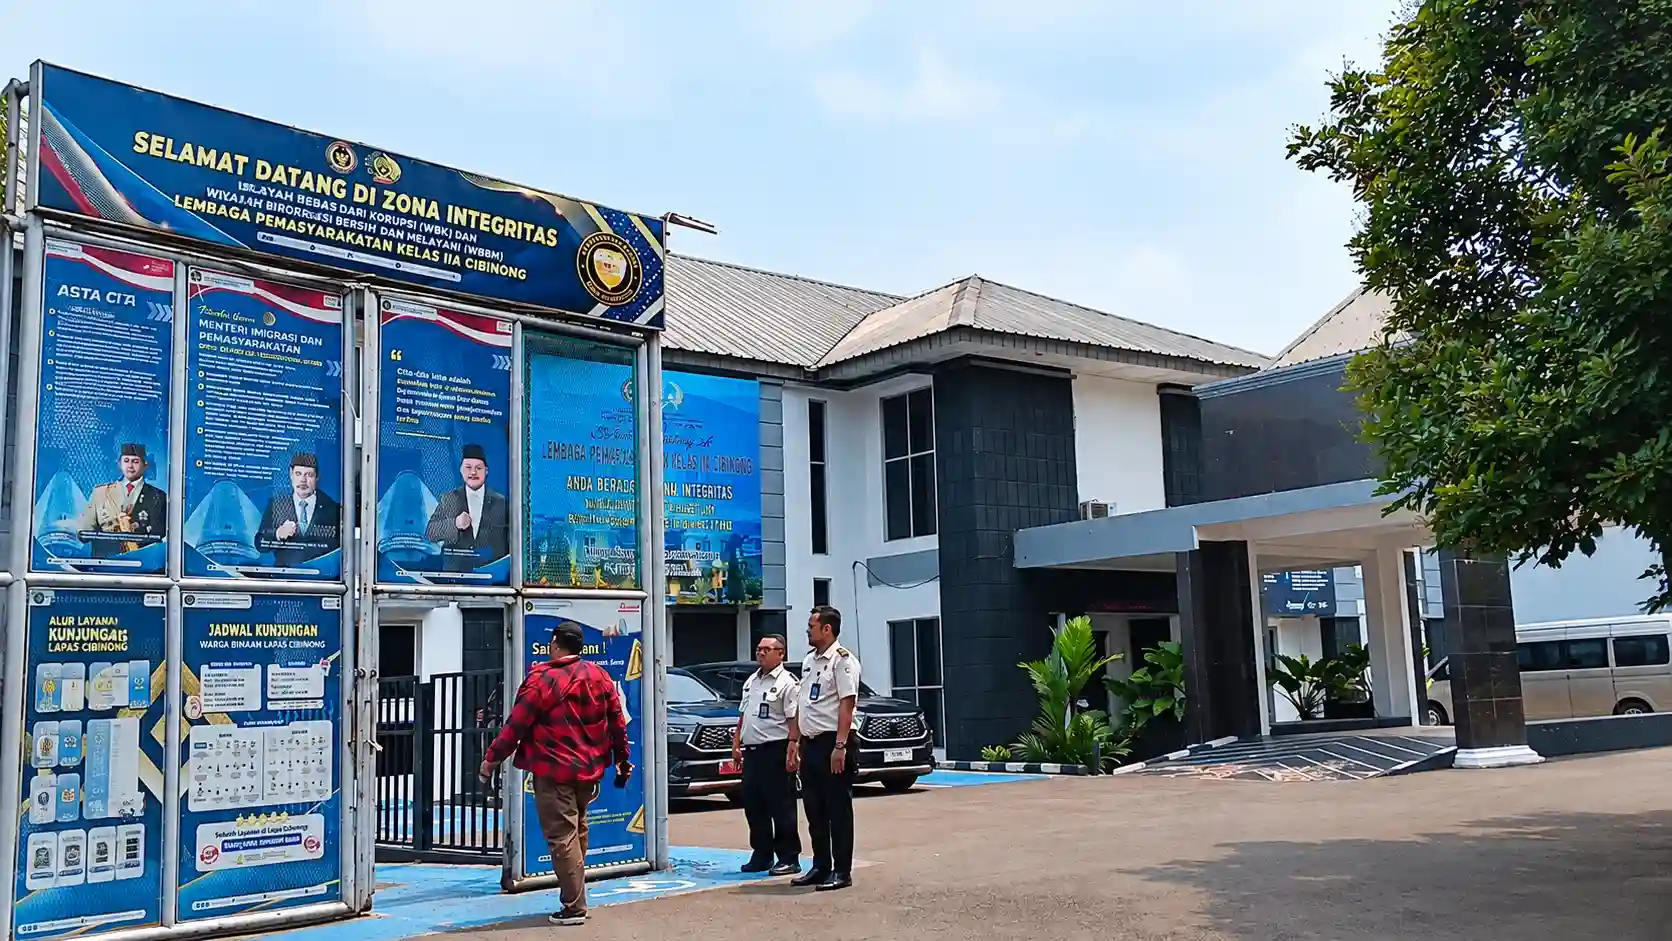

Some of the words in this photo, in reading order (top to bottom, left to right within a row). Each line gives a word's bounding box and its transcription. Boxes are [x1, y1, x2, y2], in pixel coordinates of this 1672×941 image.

[133, 131, 249, 175] SELAMAT
[255, 159, 347, 199] DATANG
[353, 183, 376, 206] DI
[382, 189, 440, 220] ZONA
[447, 204, 558, 247] INTEGRITAS
[297, 194, 337, 211] BEBAS
[339, 204, 366, 218] DARI
[370, 211, 417, 230] KORUPSI
[420, 222, 452, 239] (WBK)
[455, 231, 477, 242] DAN
[174, 194, 250, 222] LEMBAGA
[255, 212, 393, 252] PEMASYARAKATAN
[396, 242, 440, 262] KELAS
[444, 253, 461, 267] IIA
[465, 258, 527, 280] CIBINONG
[336, 215, 376, 233] BERSIH
[380, 226, 404, 240] DAN
[407, 232, 461, 252] MELAYANI
[464, 244, 504, 262] (WBBM)
[57, 284, 100, 302] ASTA
[199, 319, 248, 335] MENTERI
[251, 327, 297, 343] IMIGRASI
[300, 336, 323, 346] DAN
[199, 331, 301, 355] PEMASYARAKATAN
[566, 475, 593, 492] ANDA
[682, 482, 733, 500] INTEGRITAS
[49, 616, 75, 626] ALUR
[208, 623, 253, 637] JADWAL
[255, 624, 318, 637] KUNJUNGAN
[48, 642, 79, 652] LAPAS
[81, 641, 128, 653] CIBINONG
[200, 640, 230, 649] WARGA
[264, 640, 288, 649] LAPAS
